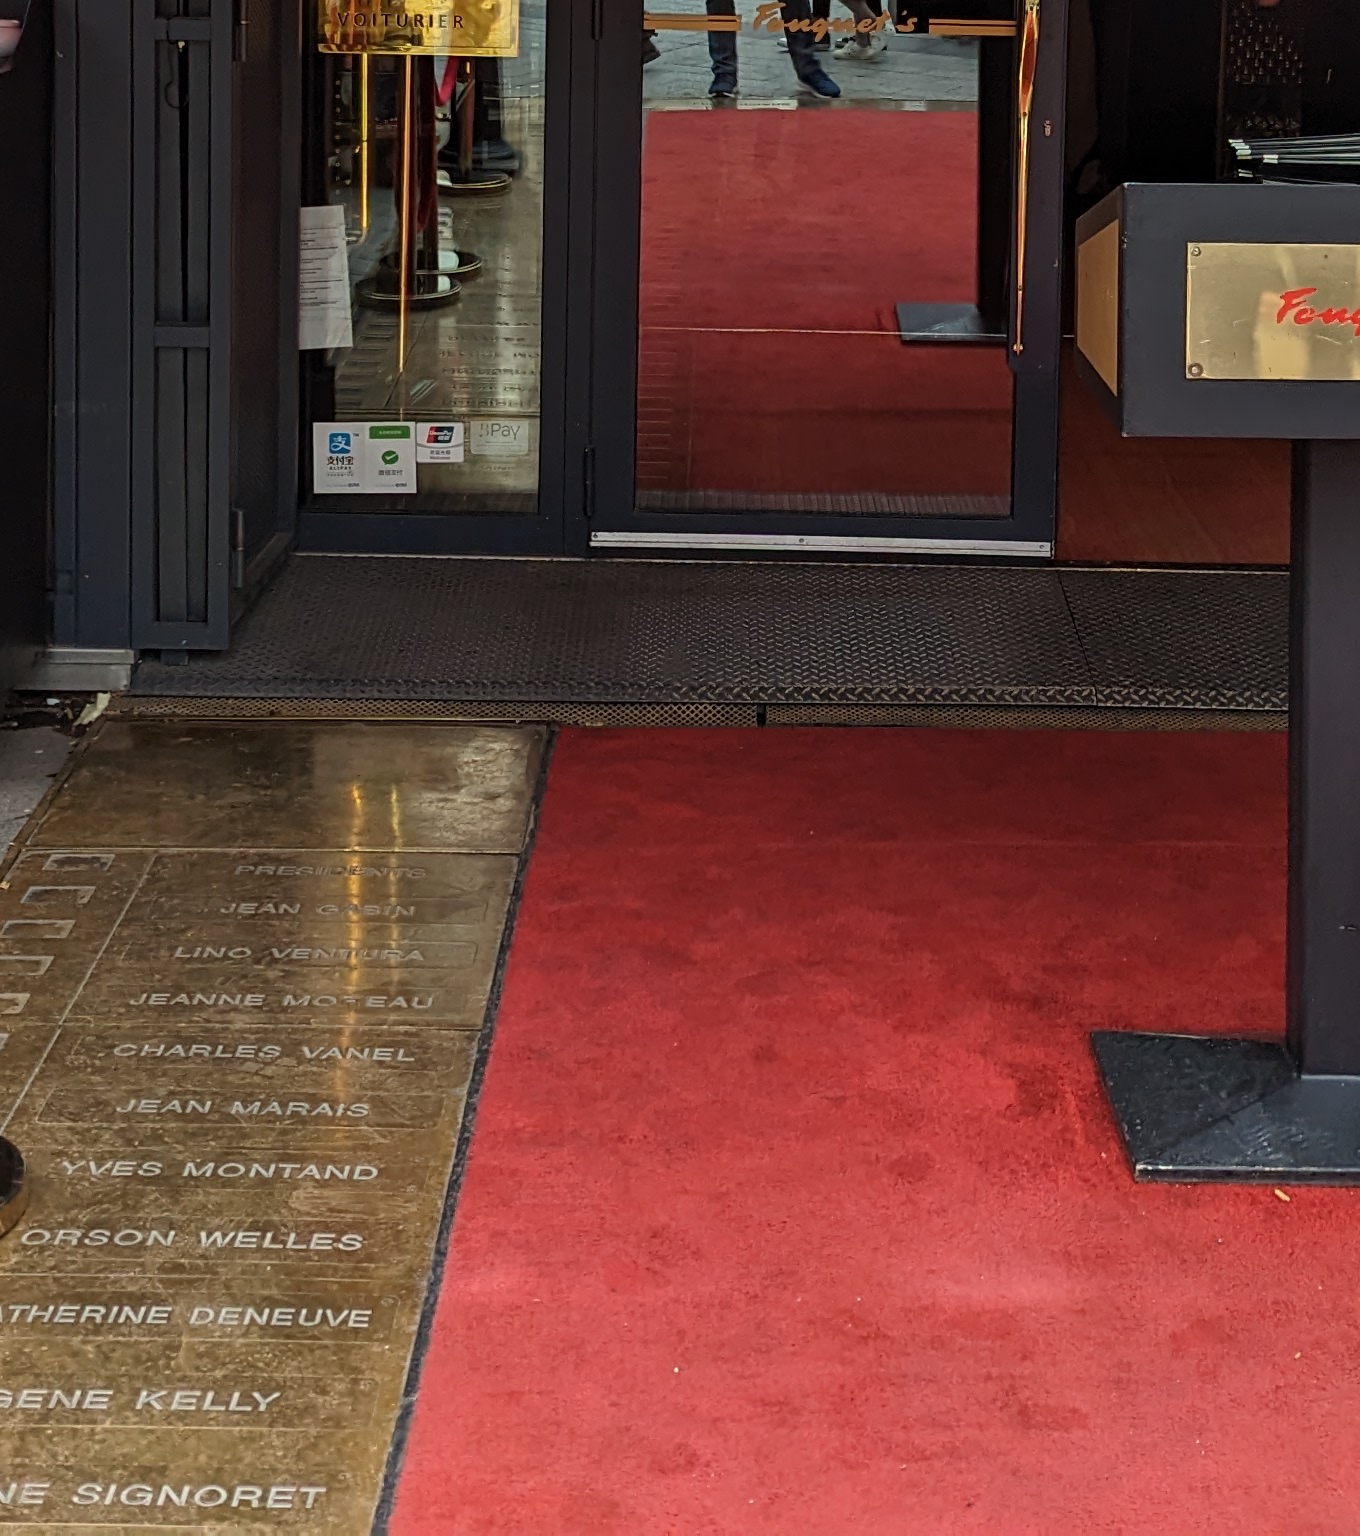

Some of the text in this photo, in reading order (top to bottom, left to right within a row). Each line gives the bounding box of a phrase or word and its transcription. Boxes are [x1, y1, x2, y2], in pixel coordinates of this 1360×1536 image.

[337, 12, 464, 29] VOITURIER
[753, 1, 917, 42] Fouquet's
[220, 902, 301, 915] JEAN
[174, 947, 425, 962] LINO VENTURA
[129, 992, 266, 1007] JEANNE
[113, 1043, 416, 1062] CHARLES VANEL
[116, 1098, 371, 1118] JEAN MARAIS
[60, 1161, 379, 1181] YVES MONTAND
[21, 1229, 365, 1251] ORSON WELLES
[188, 1306, 373, 1328] DENEUVE
[135, 1389, 282, 1412] KELLY
[70, 1483, 327, 1509] SIGNORET
